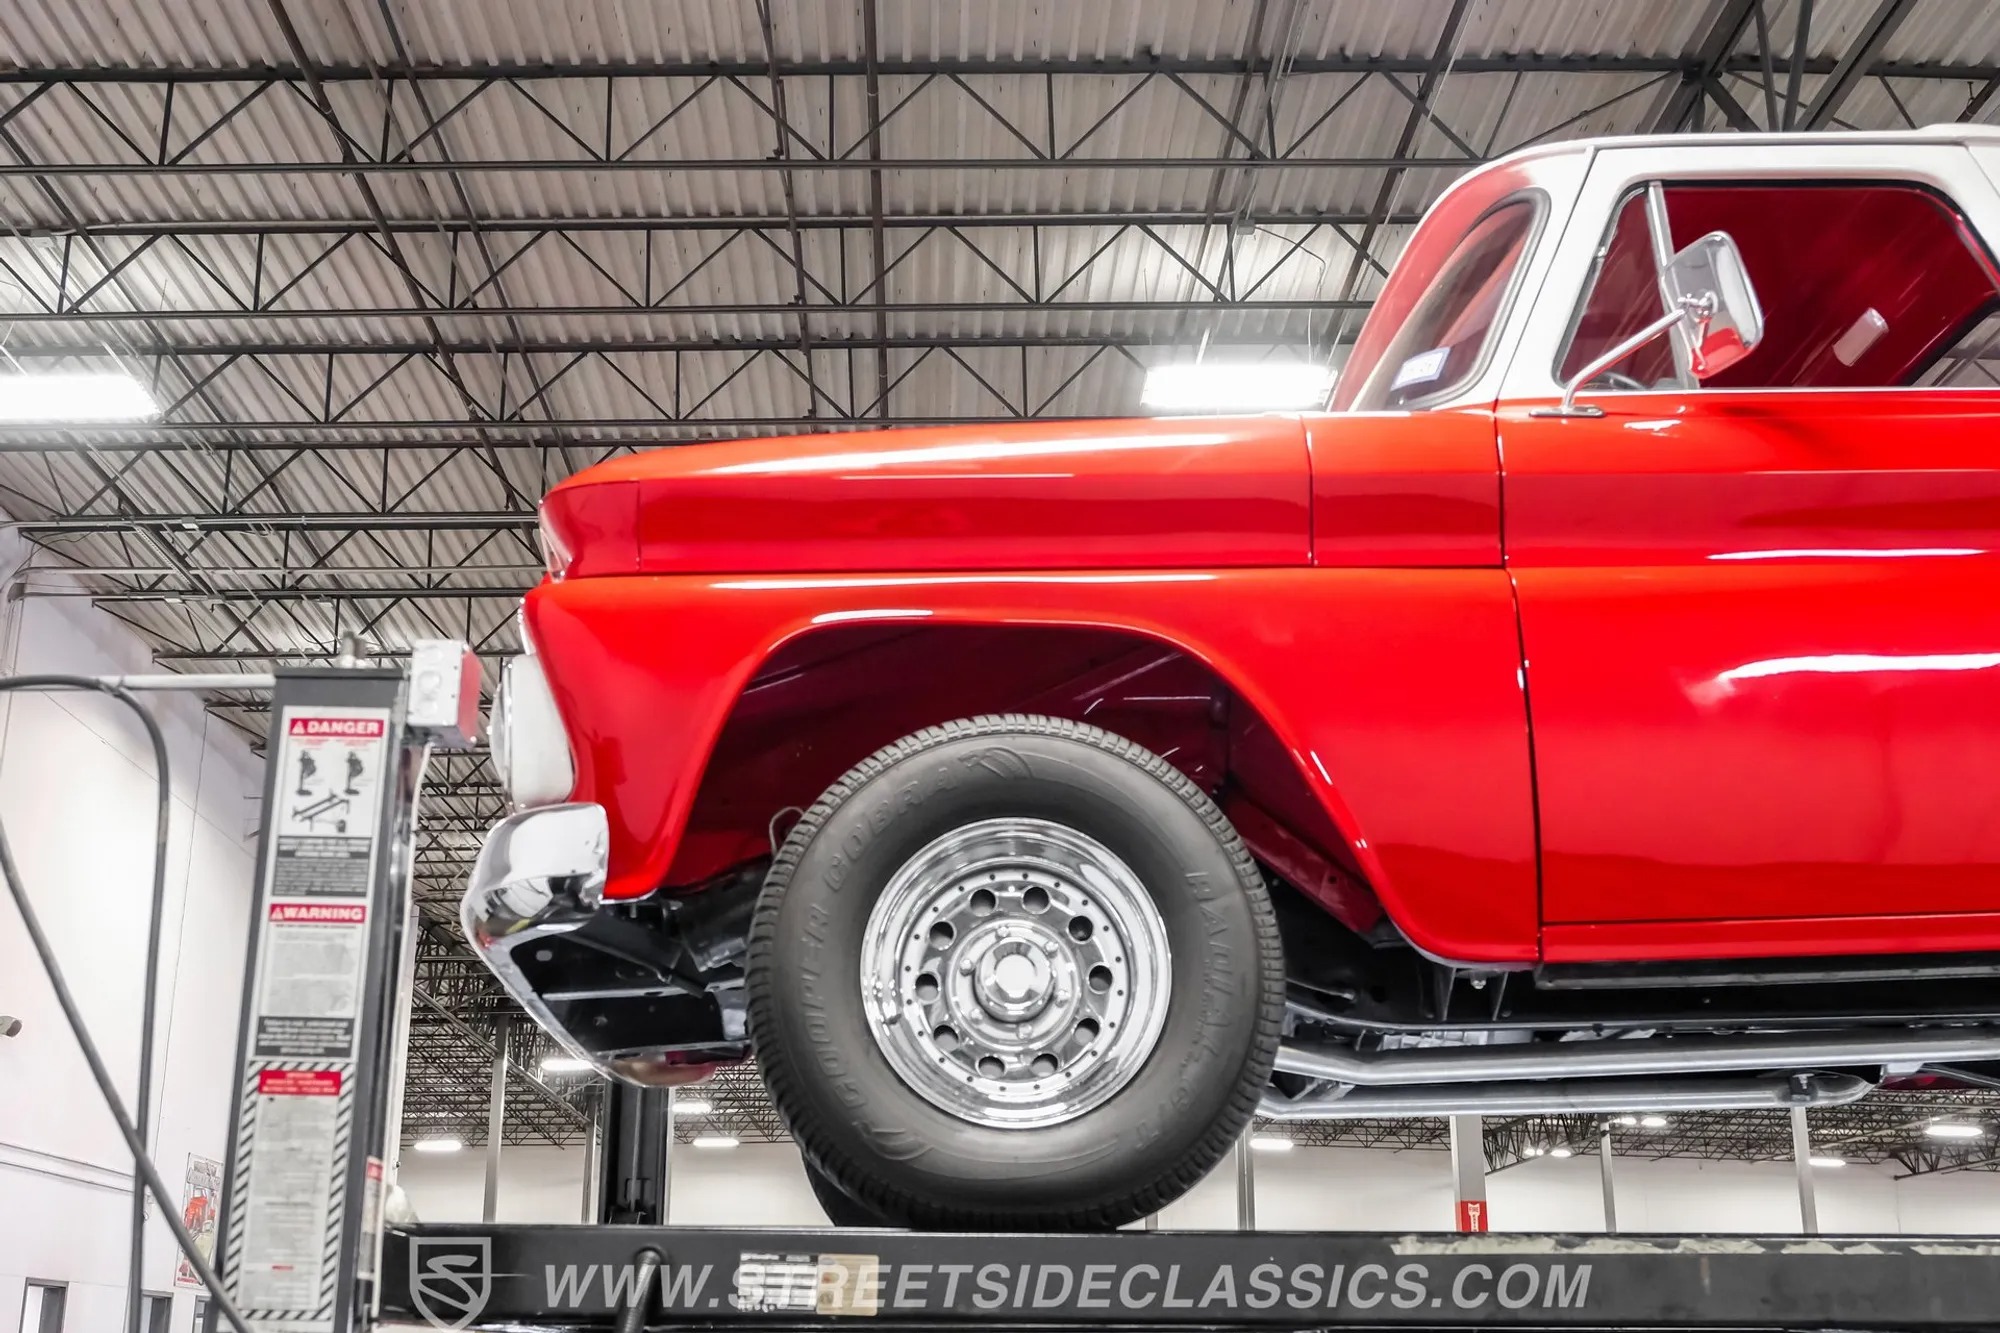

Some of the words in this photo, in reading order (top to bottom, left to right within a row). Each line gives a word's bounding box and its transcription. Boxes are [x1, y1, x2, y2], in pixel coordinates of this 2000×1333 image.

[306, 720, 379, 735] DANGER
[822, 765, 960, 894] COBRA
[282, 906, 364, 921] WARNING
[800, 903, 868, 1109] COOPER
